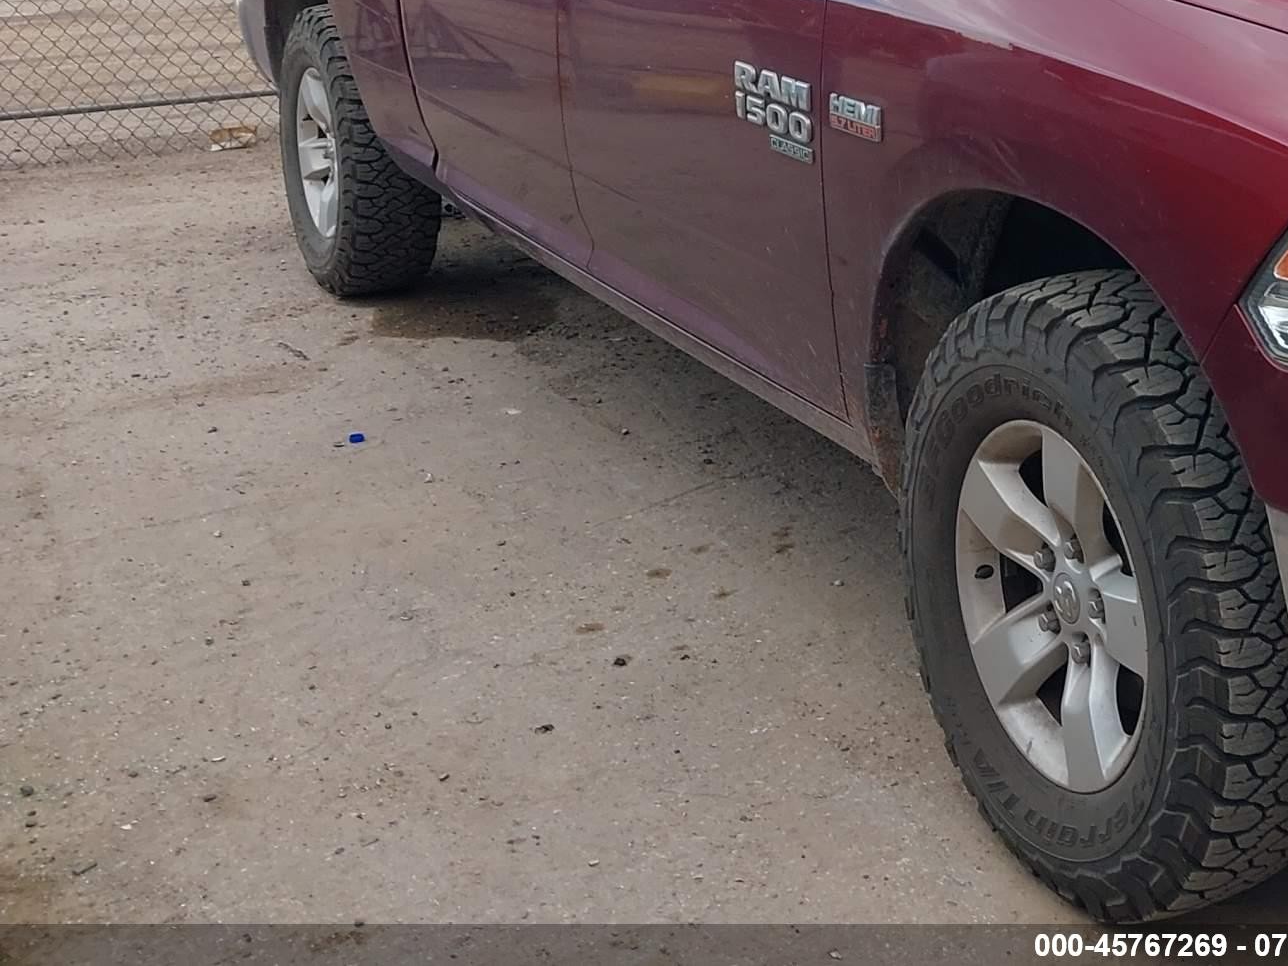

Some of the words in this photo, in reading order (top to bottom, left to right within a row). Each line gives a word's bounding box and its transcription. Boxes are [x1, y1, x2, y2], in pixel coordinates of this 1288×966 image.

[735, 60, 811, 111] RAM
[735, 90, 813, 143] 1500
[829, 92, 881, 126] HEMI
[848, 118, 878, 140] LITER
[770, 138, 811, 160] CLASSIC
